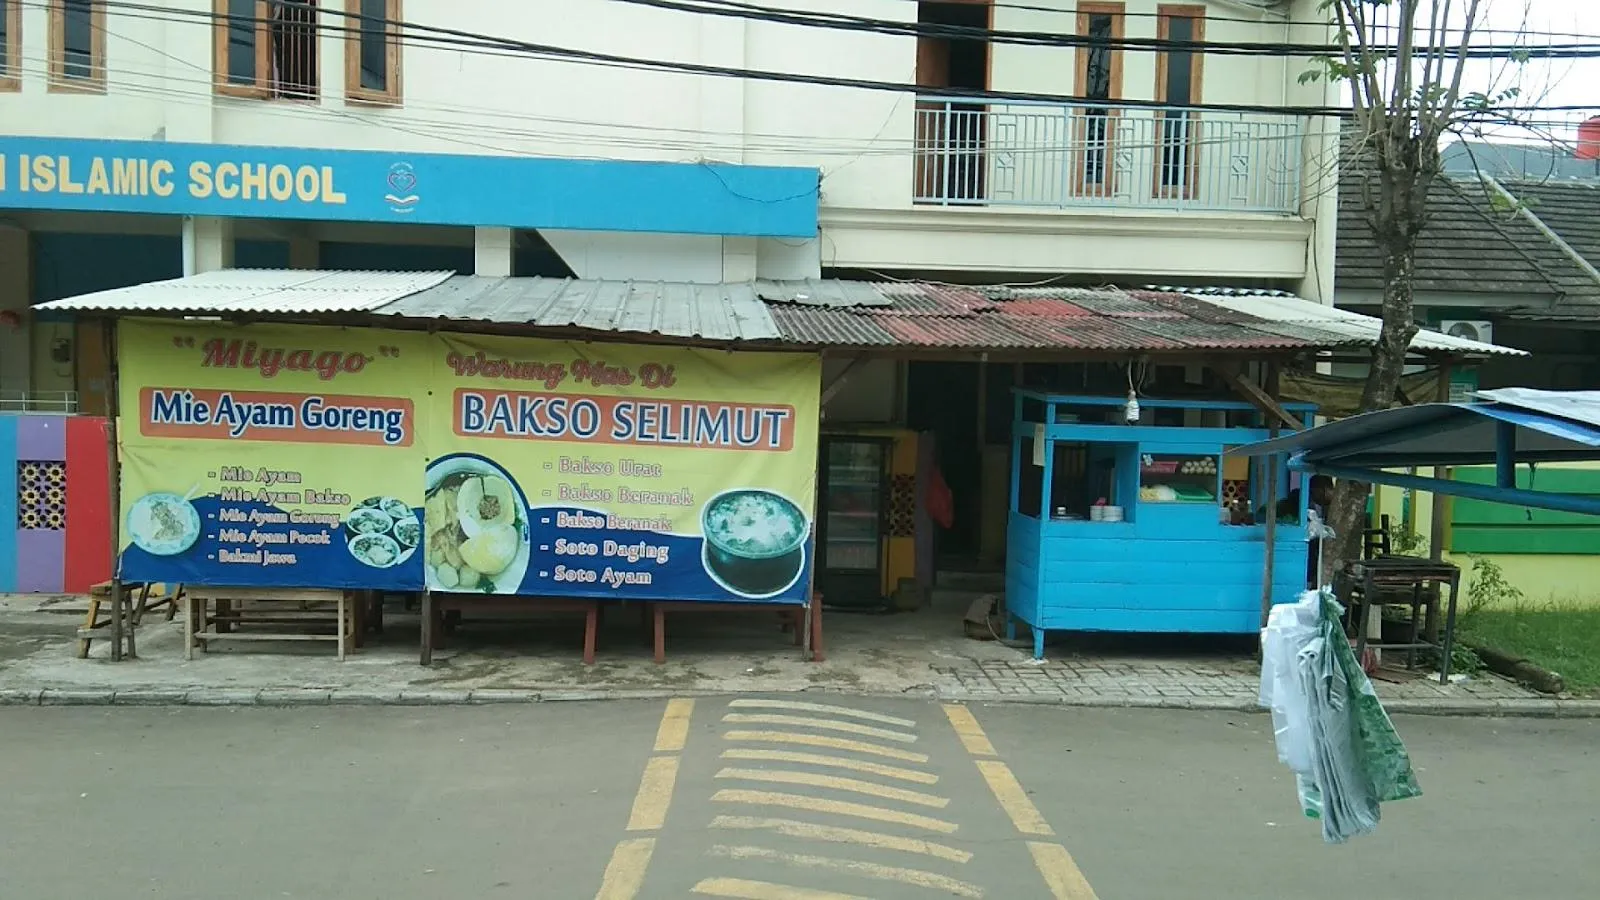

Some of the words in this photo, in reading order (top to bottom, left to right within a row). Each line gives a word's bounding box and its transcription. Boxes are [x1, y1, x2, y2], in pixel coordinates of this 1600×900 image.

[19, 153, 175, 197] ISLAMIC
[188, 160, 347, 204] SCHOOL
[446, 351, 567, 390] Warung
[570, 358, 635, 387] Mas
[638, 362, 677, 389] Di
[151, 389, 209, 424] Mie
[213, 391, 295, 438] Ayam
[299, 396, 403, 444] Goreng
[461, 391, 601, 438] BAKSO
[611, 401, 790, 448] SELIMUT
[220, 466, 253, 481] Mie
[256, 467, 301, 486] Ayam
[559, 456, 614, 475] Bakso
[619, 459, 662, 477] Urat
[220, 486, 253, 502] Mie
[256, 488, 301, 507] Ayam
[304, 488, 351, 505] Bakso
[558, 483, 612, 502] Bakso
[618, 486, 694, 506] Beranak
[219, 508, 247, 522] Mie
[248, 508, 288, 527] Ayam
[289, 509, 340, 529] Goreng
[556, 511, 605, 529] Bakso
[606, 513, 672, 532] Beranak
[219, 528, 247, 542] Mie
[248, 530, 288, 547] Ayam
[219, 548, 262, 563] Bakmi
[554, 538, 598, 555] Soto
[603, 540, 669, 564] Daging
[553, 564, 597, 582] Soto
[600, 566, 652, 588] Ayam
